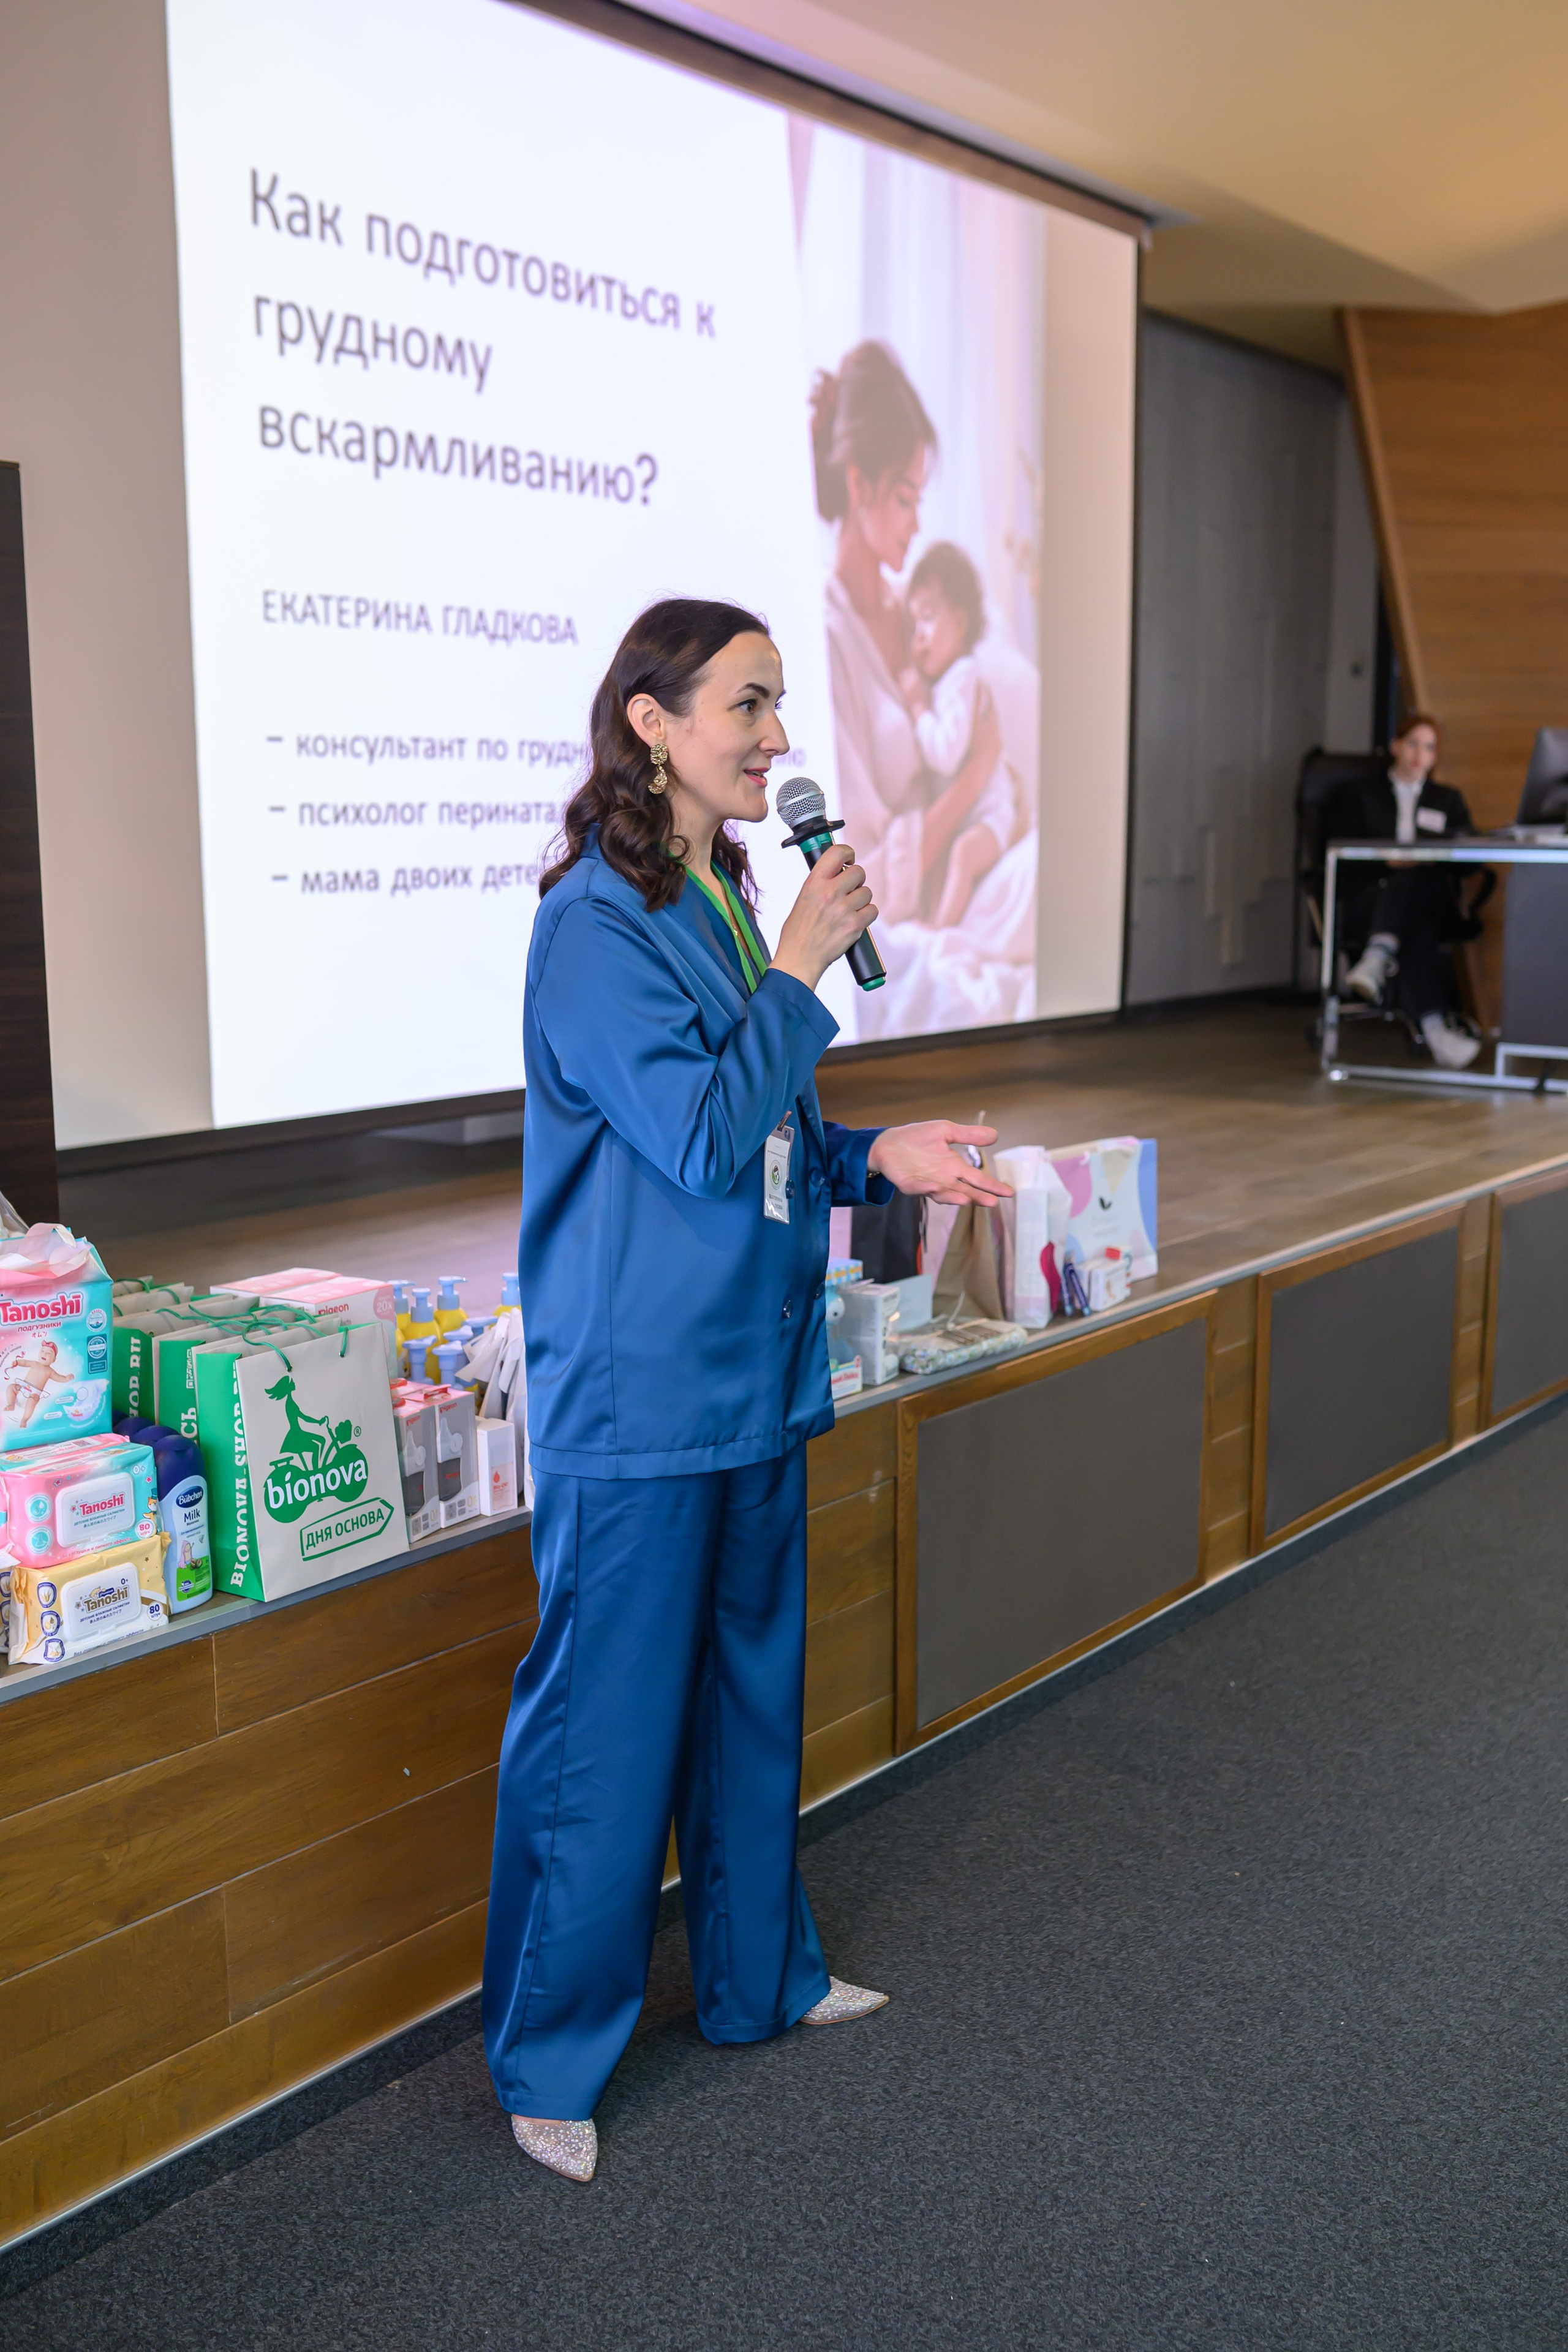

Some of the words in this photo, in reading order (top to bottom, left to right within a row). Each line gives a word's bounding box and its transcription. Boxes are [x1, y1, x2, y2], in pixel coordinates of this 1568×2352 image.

[251, 168, 342, 246] Как
[366, 213, 680, 331] подготовиться
[696, 302, 716, 339] к
[254, 295, 492, 393] грудному
[258, 405, 658, 506] вскармливанию?
[262, 589, 433, 634] ЕКАТЕРИНА
[442, 605, 578, 646] ГЛАДКОВА
[296, 734, 467, 766] консультант
[477, 737, 509, 762] по
[298, 802, 428, 827] психолог
[301, 869, 380, 893] мама
[390, 867, 472, 897] двоих
[18, 1322, 61, 1332] ПОДГУЗНИКИ
[178, 1490, 203, 1505] Bübchen
[267, 1458, 368, 1510] bionova
[184, 1508, 201, 1523] Milk
[306, 1529, 333, 1551] ДНЯ
[334, 1508, 385, 1539] ОСНОВА
[149, 1604, 160, 1615] 80
